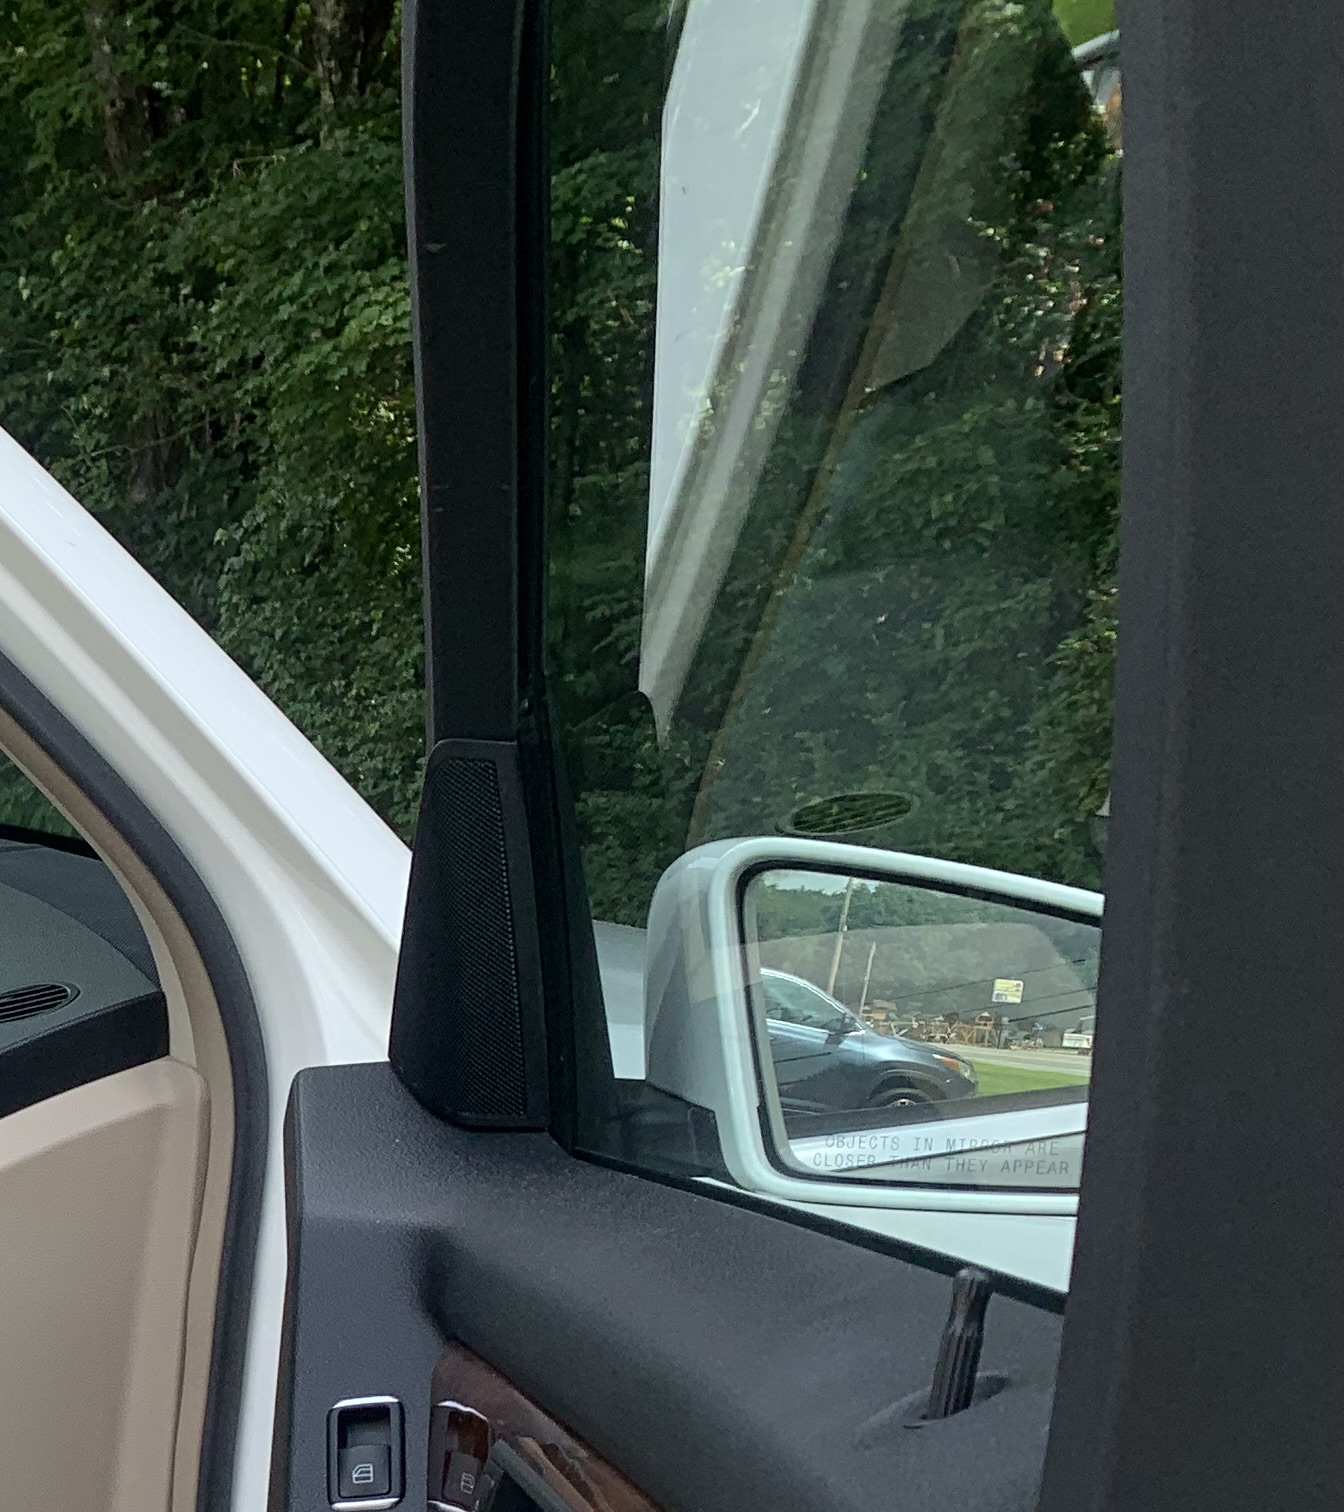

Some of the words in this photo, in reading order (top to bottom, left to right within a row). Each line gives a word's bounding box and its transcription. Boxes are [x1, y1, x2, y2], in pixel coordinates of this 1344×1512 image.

[825, 1133, 900, 1151] OBJECTS
[913, 1136, 933, 1151] IN
[1025, 1140, 1059, 1157] ARE
[813, 1152, 876, 1169] CLOSER
[944, 1156, 988, 1173] THEY
[1000, 1159, 1069, 1175] APPEAR
